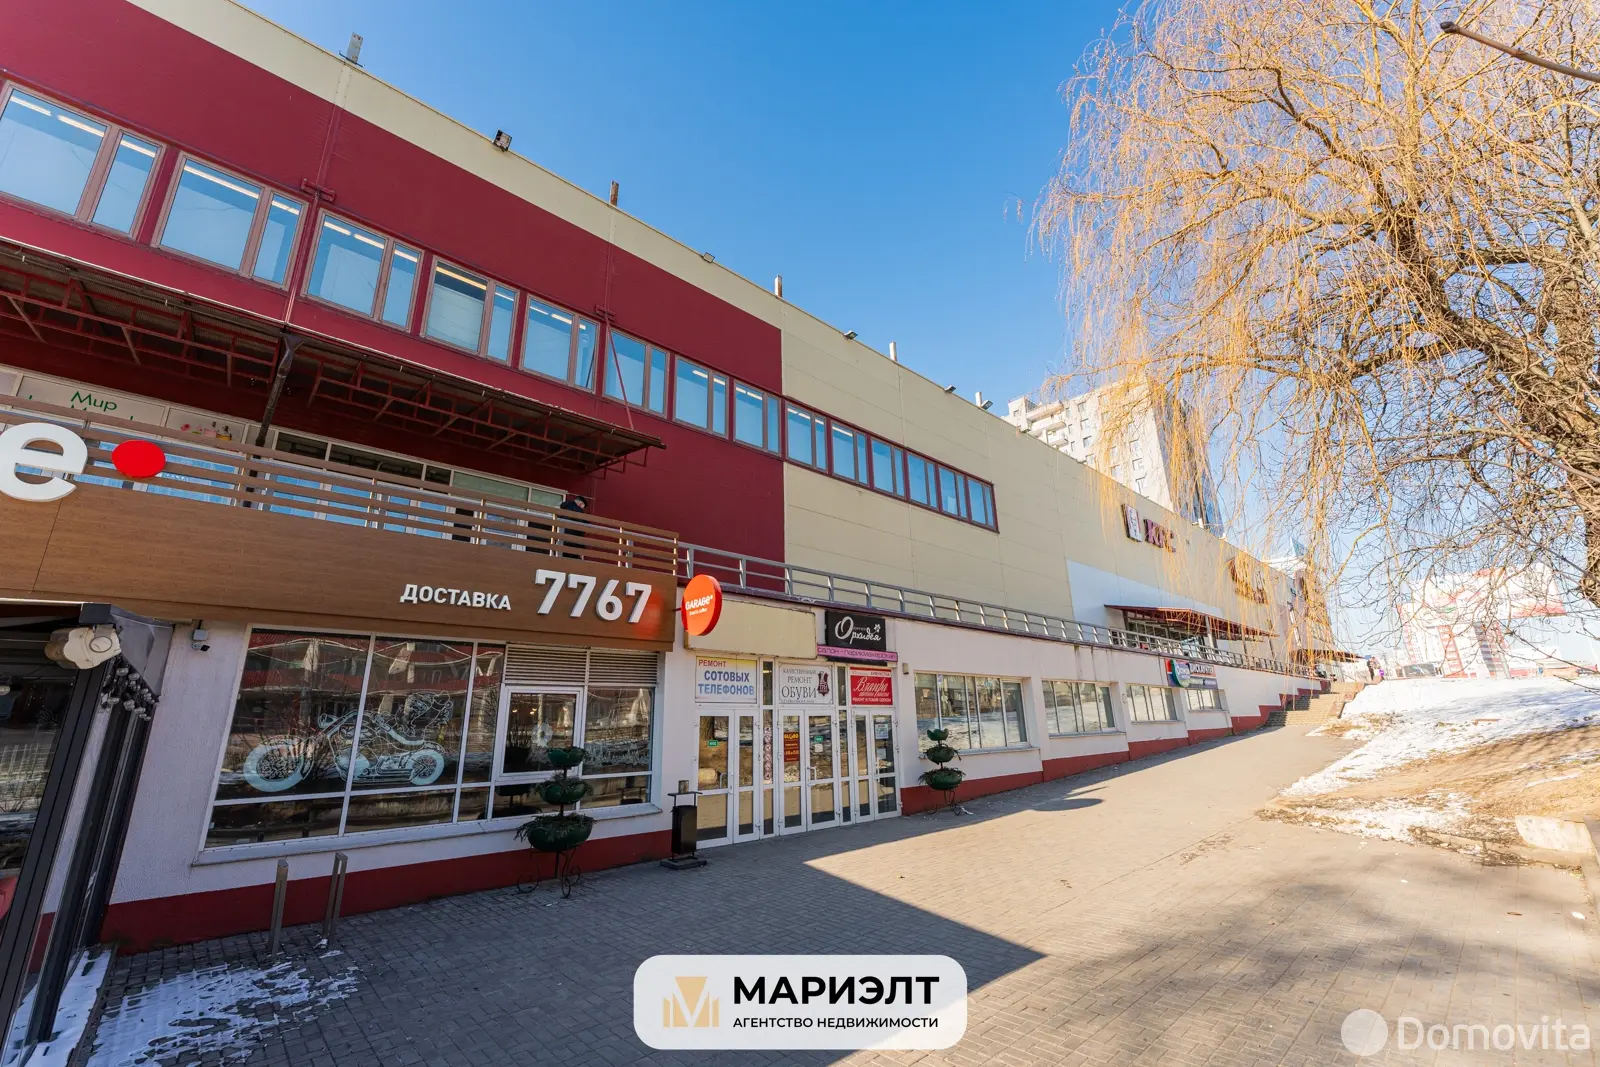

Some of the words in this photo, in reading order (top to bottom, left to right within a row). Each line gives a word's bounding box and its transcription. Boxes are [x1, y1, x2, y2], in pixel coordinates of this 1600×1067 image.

[400, 583, 512, 611] ДОСТАВКА
[534, 568, 653, 624] 7767
[834, 616, 882, 645] Орхидея
[698, 659, 727, 668] РЕМОНТ
[704, 670, 750, 683] СОТОВЫХ
[787, 675, 813, 684] РЕМОНТ
[697, 683, 755, 696] ТЕЛЕФОНОВ
[781, 685, 817, 700] ОБУВИ
